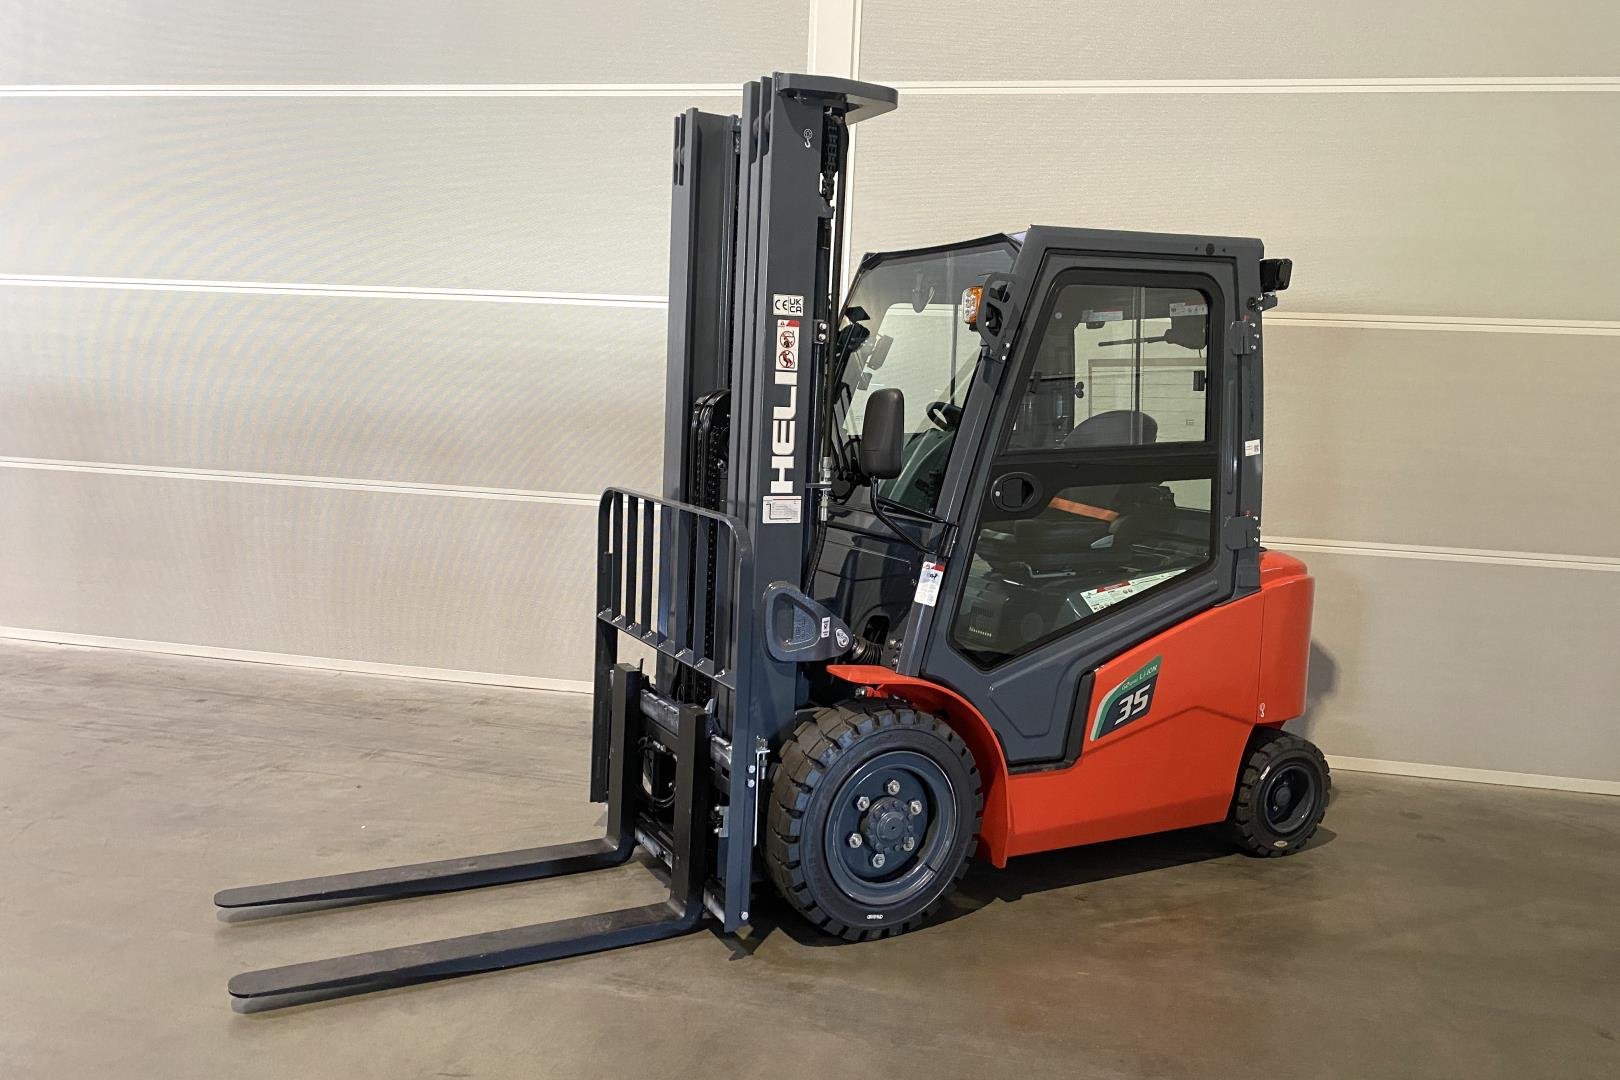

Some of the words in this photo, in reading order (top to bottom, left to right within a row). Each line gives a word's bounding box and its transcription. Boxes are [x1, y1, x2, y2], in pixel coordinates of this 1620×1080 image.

[775, 299, 788, 310] CE
[770, 371, 798, 494] HELI
[1114, 684, 1151, 725] 35
